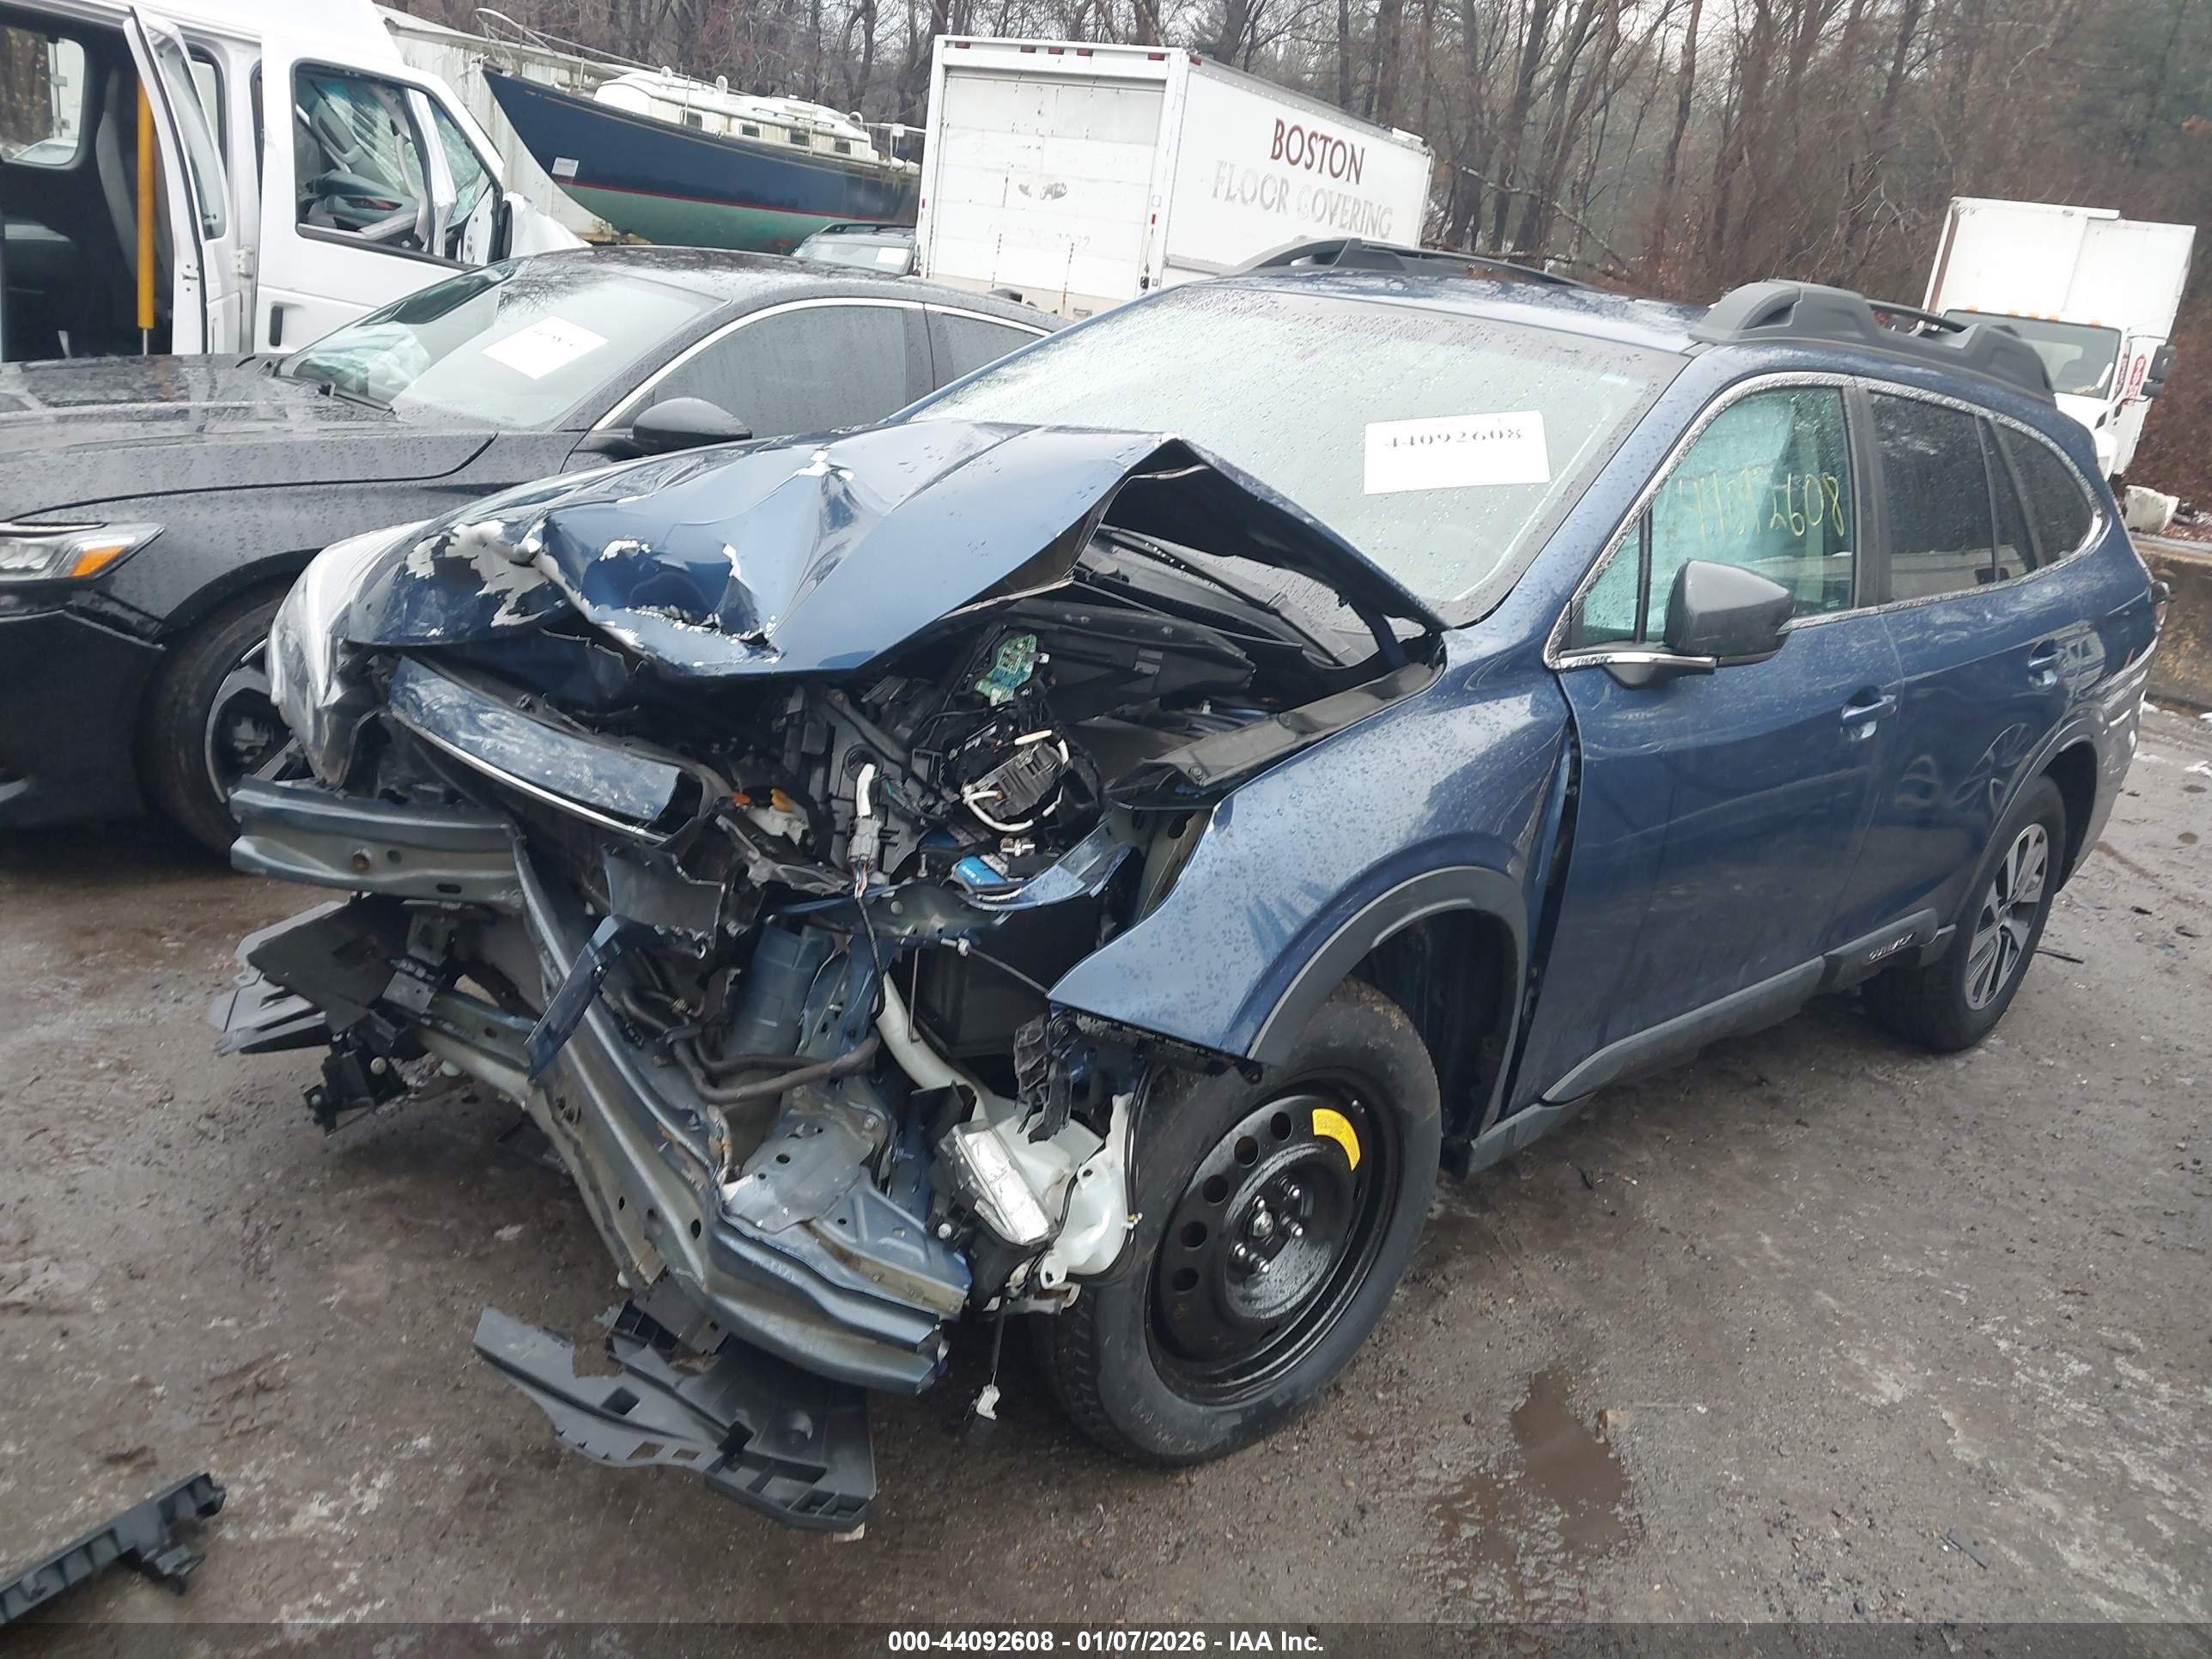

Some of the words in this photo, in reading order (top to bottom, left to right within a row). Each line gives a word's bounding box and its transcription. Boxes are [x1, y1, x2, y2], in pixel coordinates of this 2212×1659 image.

[1270, 117, 1366, 185] BOSTON
[1212, 159, 1289, 215] FLOOR
[1297, 184, 1394, 240] COVERING
[1383, 428, 1522, 448] 44092608
